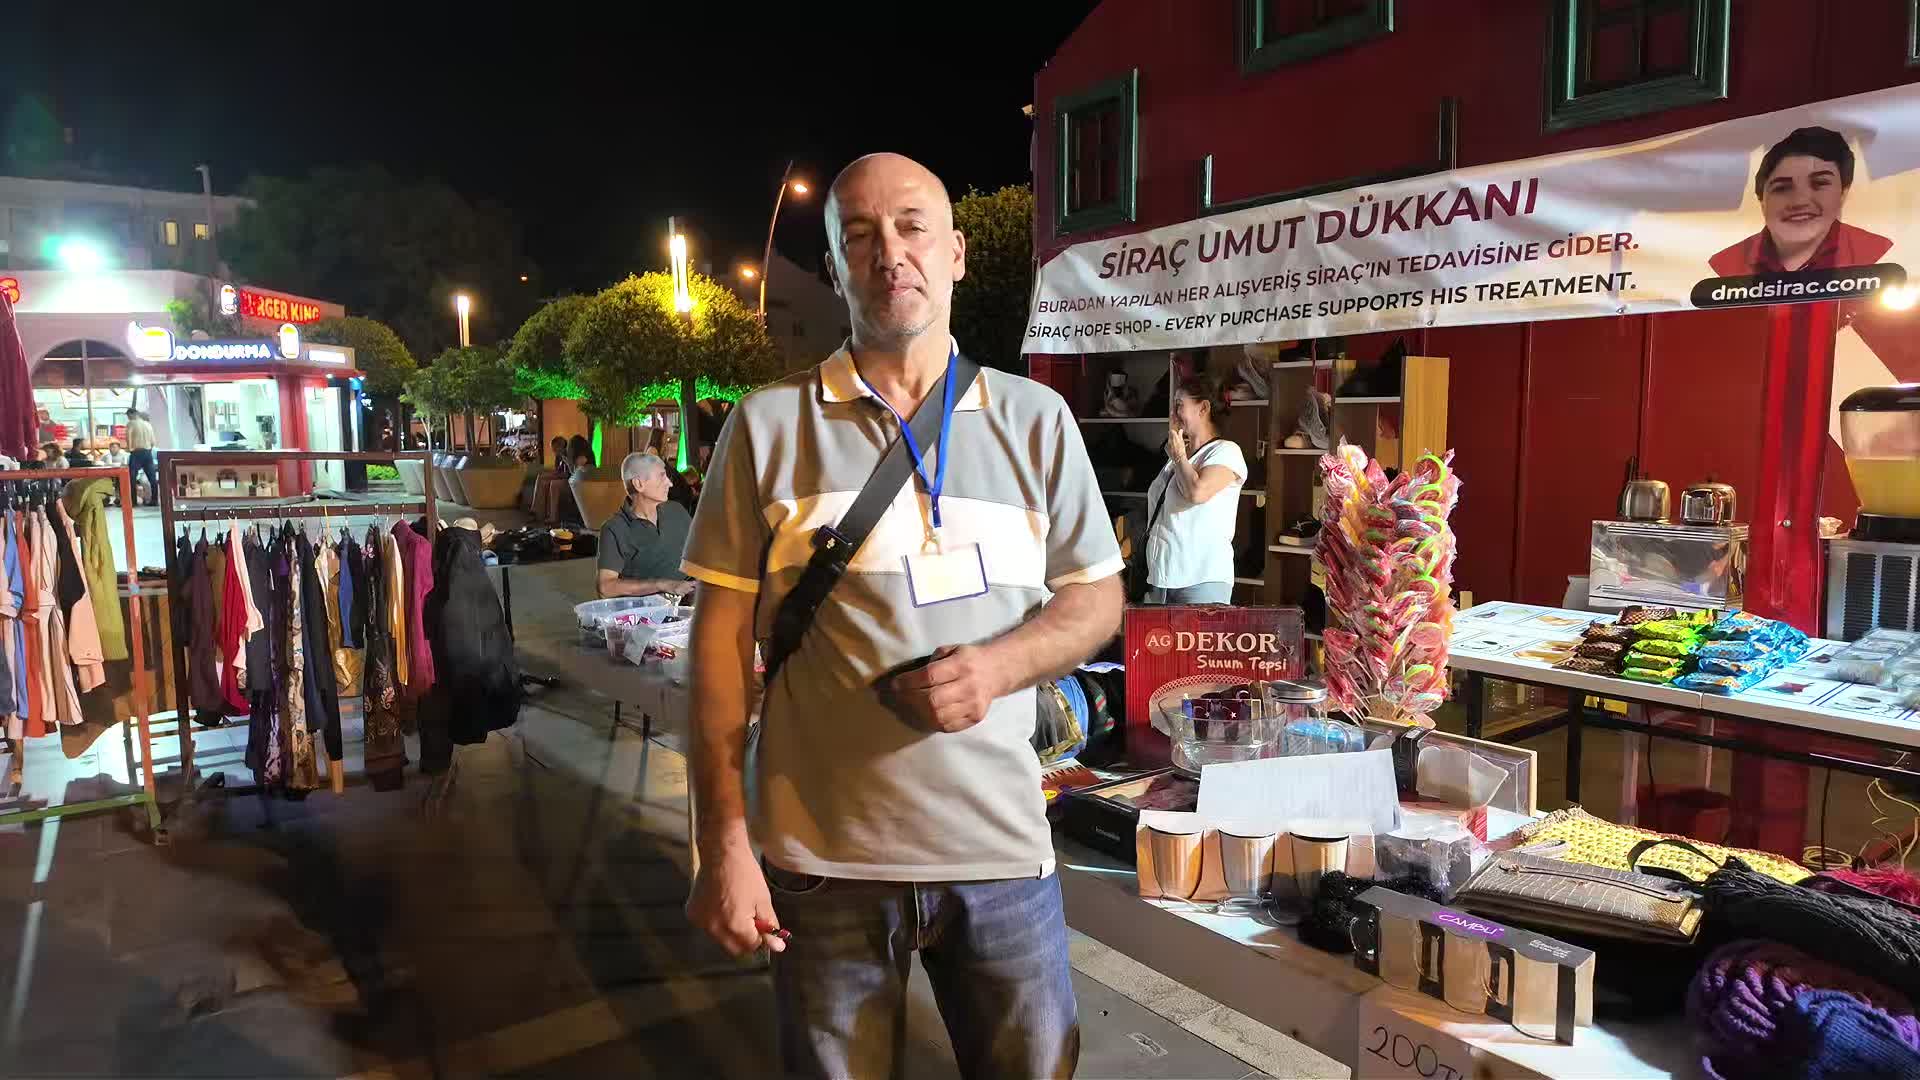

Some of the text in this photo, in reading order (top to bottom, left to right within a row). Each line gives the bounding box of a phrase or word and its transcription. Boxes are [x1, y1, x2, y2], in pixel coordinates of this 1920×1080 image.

[1098, 177, 1539, 279] SİRAÇ UMUT DÜKKANI
[1038, 232, 1639, 313] BURADAN YAPILAN HER ALIŞVERİŞ SİRAÇ'IN TEDAVİSİNE GİDER.
[1711, 274, 1881, 301] dmdsirac.com
[1028, 322, 1071, 341] SİRAÇ
[1074, 322, 1111, 337] HOPE
[1114, 319, 1151, 335] SHOP
[1165, 313, 1216, 331] EVERY
[1220, 303, 1313, 327] PURCHASE
[1318, 290, 1424, 316] SUPPORTS
[1430, 285, 1468, 305] HIS
[1475, 271, 1637, 301] TREATMENT.
[175, 343, 272, 361] DONDURMA
[1147, 631, 1279, 653] AG DEKOR
[1197, 654, 1287, 676] Sunum Tepsi
